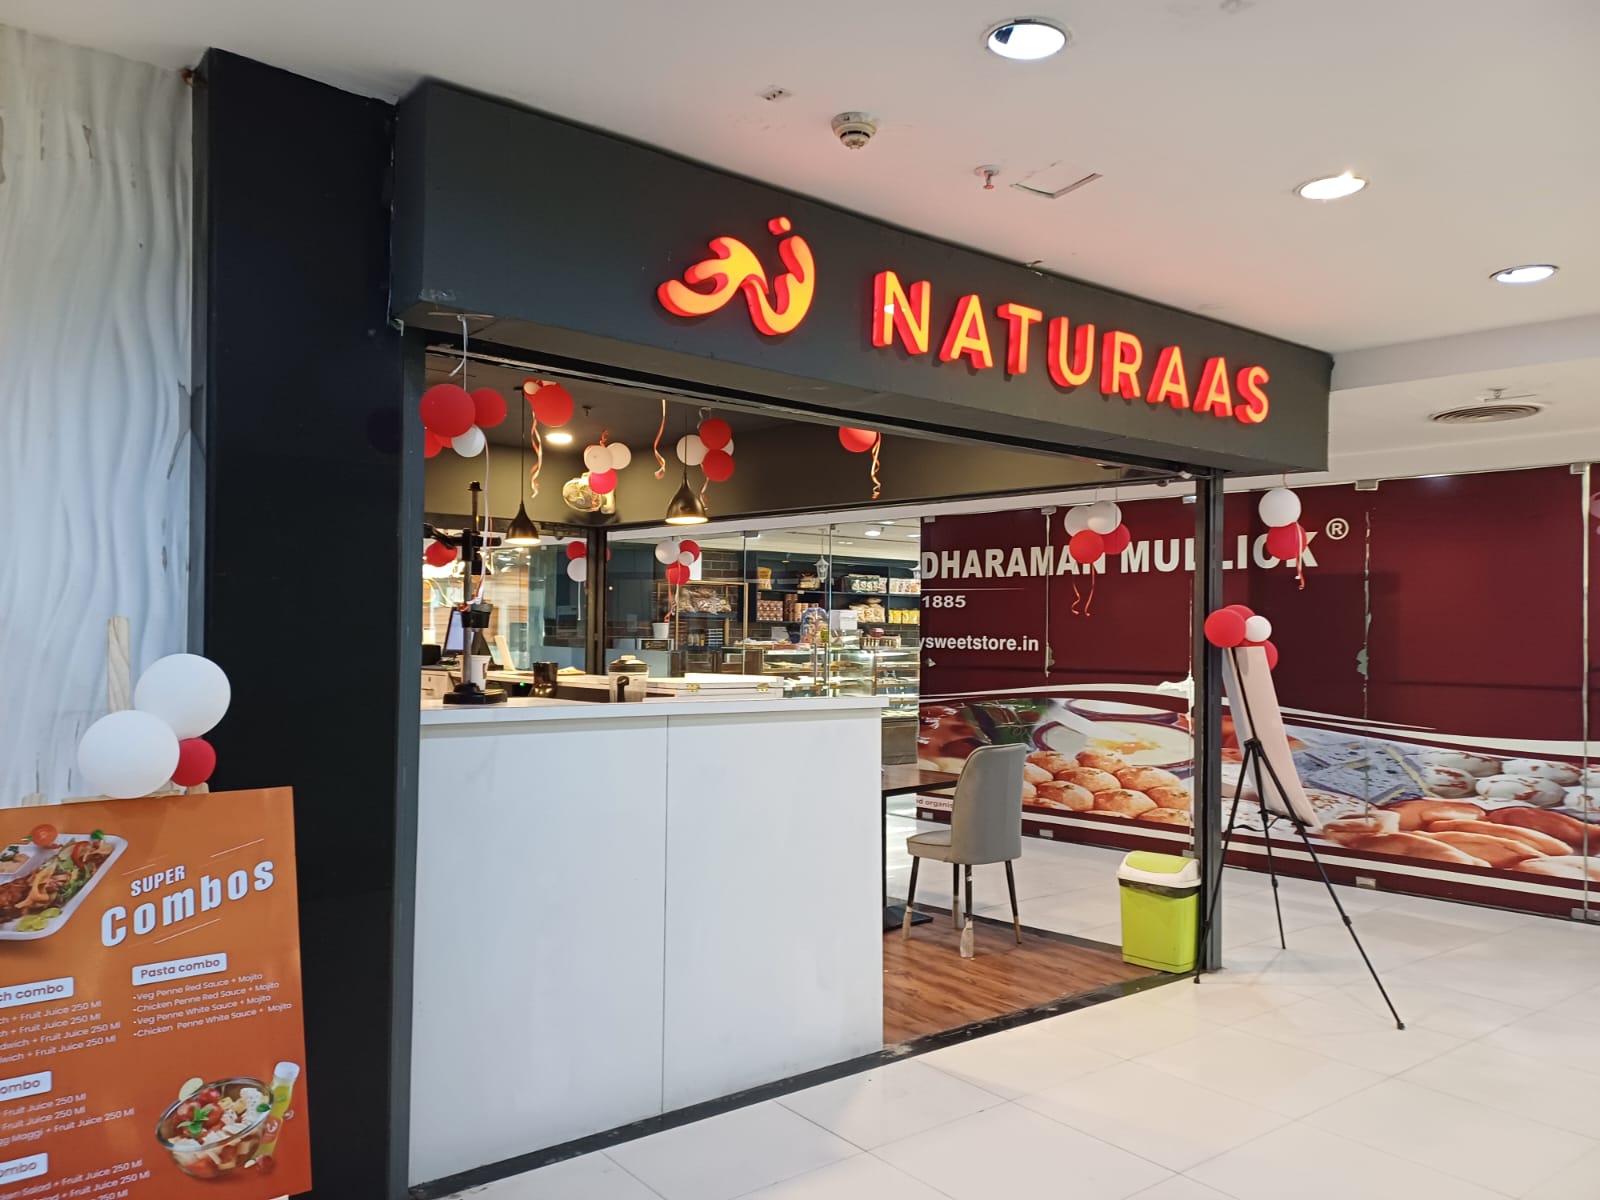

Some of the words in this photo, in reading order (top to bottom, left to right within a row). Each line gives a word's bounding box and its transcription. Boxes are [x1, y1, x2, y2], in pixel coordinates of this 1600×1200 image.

[872, 269, 1270, 424] NATURAAS
[1121, 531, 1318, 573] MULICK
[921, 595, 966, 608] 1885
[131, 865, 186, 897] SUPER
[101, 860, 275, 947] Combos
[140, 966, 176, 979] Pasta
[178, 959, 220, 973] combo
[16, 984, 64, 999] combo
